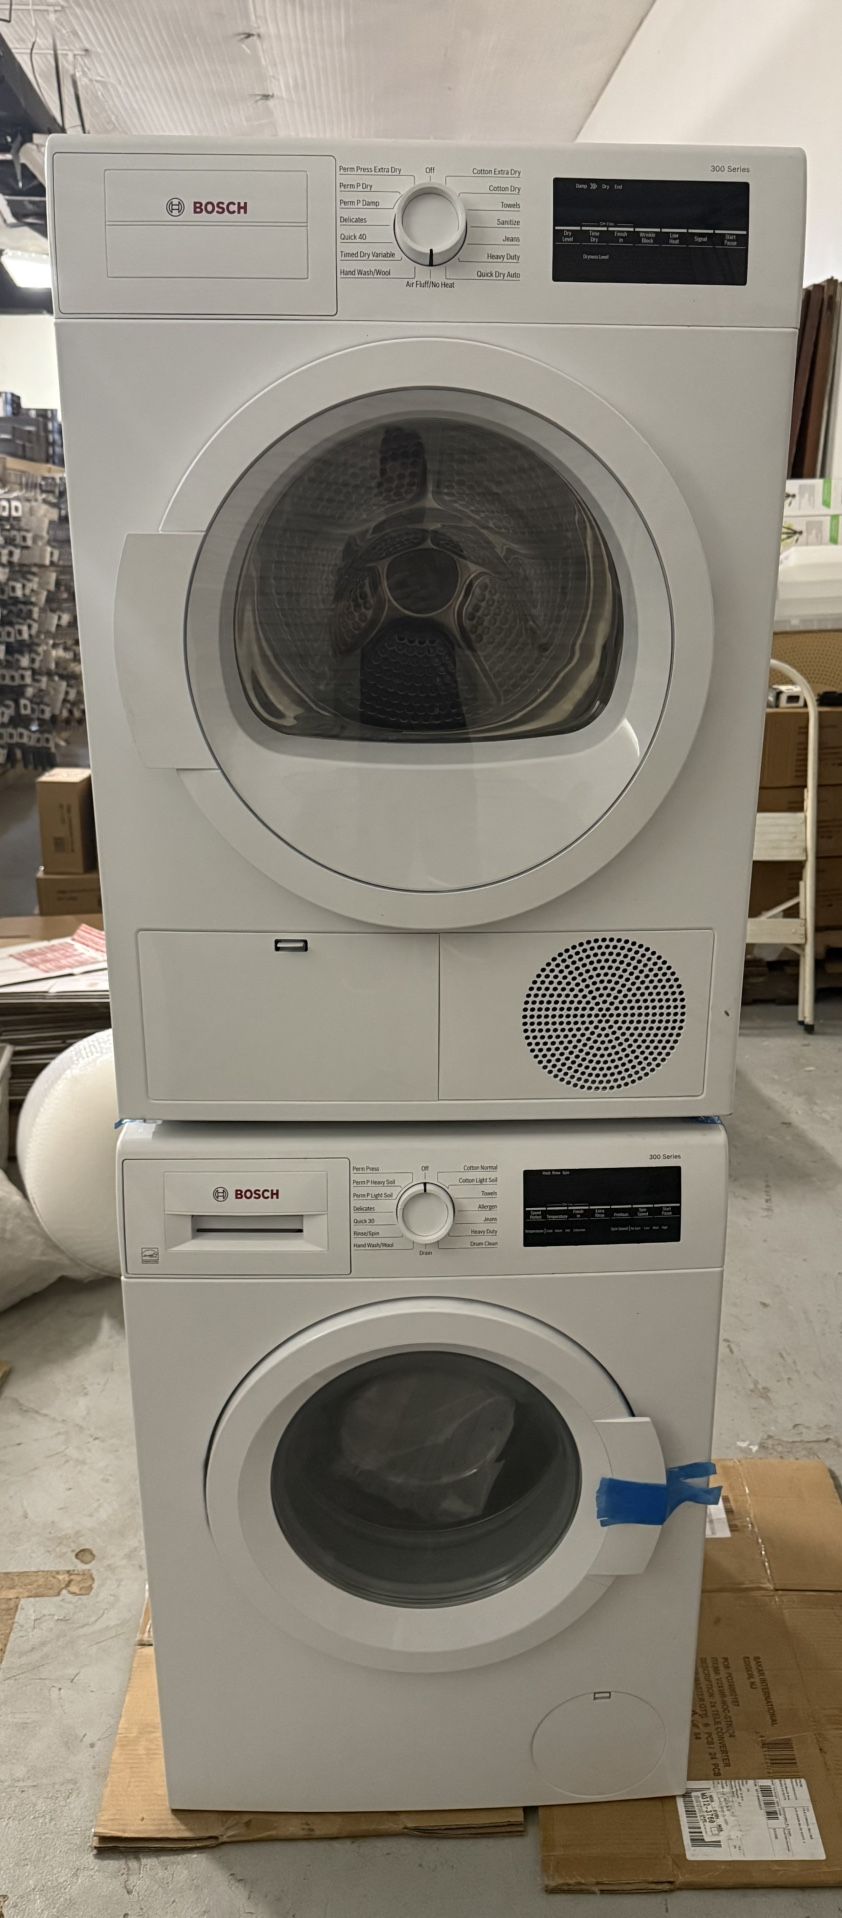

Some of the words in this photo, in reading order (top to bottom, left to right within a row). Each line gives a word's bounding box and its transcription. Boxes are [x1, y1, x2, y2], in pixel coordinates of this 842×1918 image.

[390, 167, 401, 175] Dry
[494, 168, 509, 176] Extra
[510, 169, 521, 177] Dry
[710, 165, 725, 173] 300
[727, 165, 750, 173] Series
[362, 183, 373, 191] Dry
[510, 185, 521, 194] Dry
[193, 201, 248, 215] BOSCH
[501, 201, 520, 209] Towels
[361, 251, 371, 259] Dry
[487, 253, 505, 261] Heavy
[506, 253, 520, 261] Duty
[495, 271, 505, 279] Dry
[405, 280, 414, 288] Air
[415, 280, 440, 288] Fluff/No
[234, 1189, 279, 1200] BOSCH
[759, 1678, 778, 1727] INTERNATIONAL
[715, 1727, 731, 1768] CONVERTER
[712, 1762, 722, 1777] PCS
